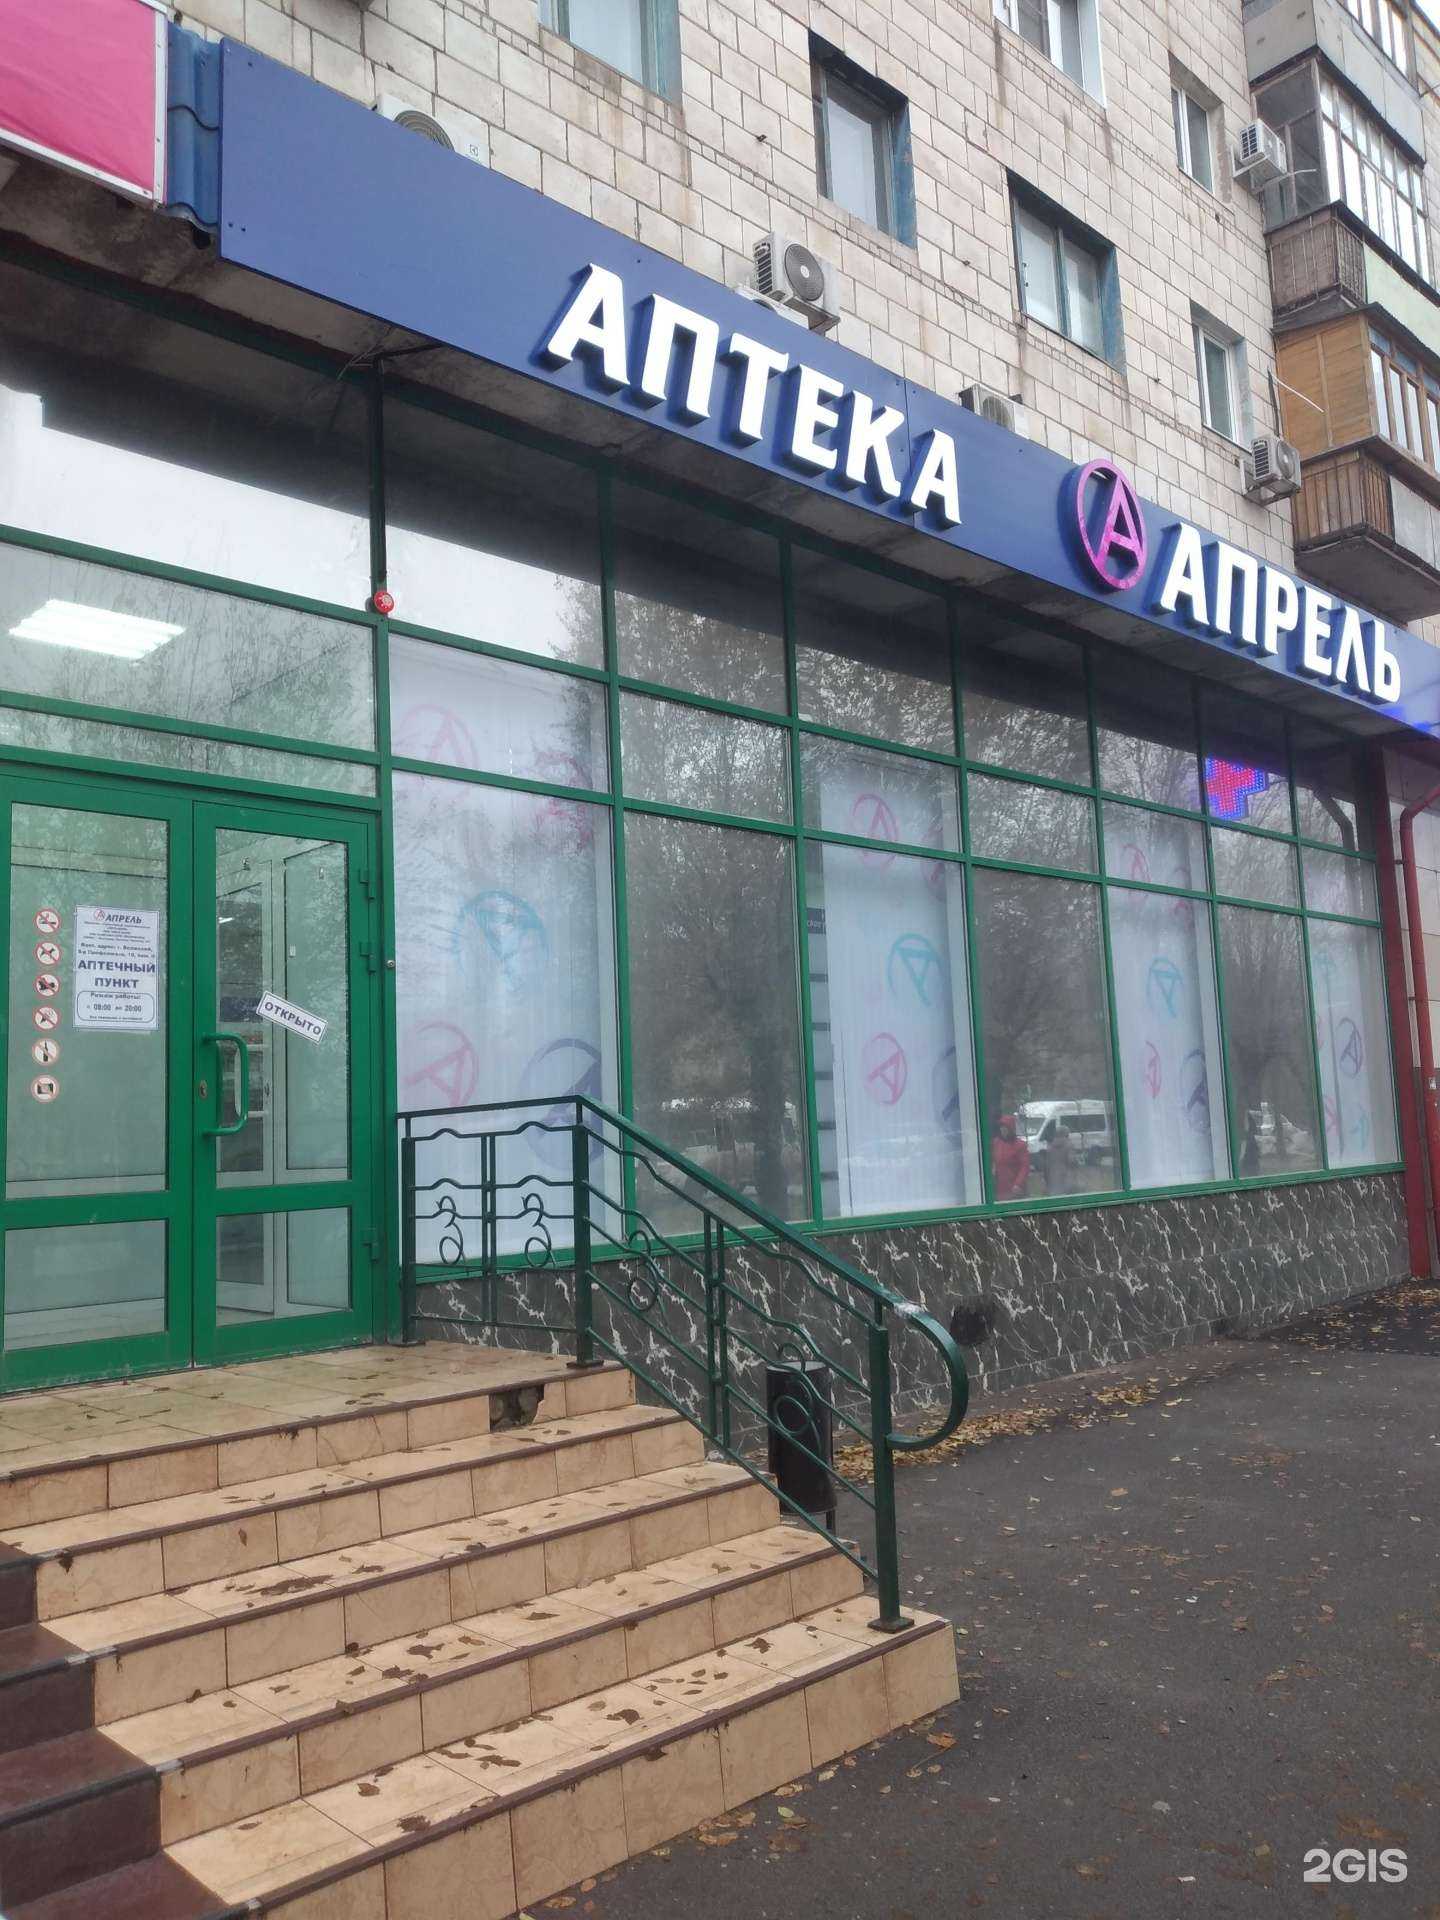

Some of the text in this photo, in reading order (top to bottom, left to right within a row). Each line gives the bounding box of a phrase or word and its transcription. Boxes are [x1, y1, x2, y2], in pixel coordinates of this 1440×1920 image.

[546, 262, 963, 525] АПТЕКА
[1159, 521, 1401, 702] АПРЕЛЬ
[105, 914, 142, 924] АПРЕЛЬ
[78, 960, 156, 973] АПТЕЧНЫЙ
[94, 977, 140, 988] ПУНКТ
[264, 1001, 322, 1036] ОТКРЫТО
